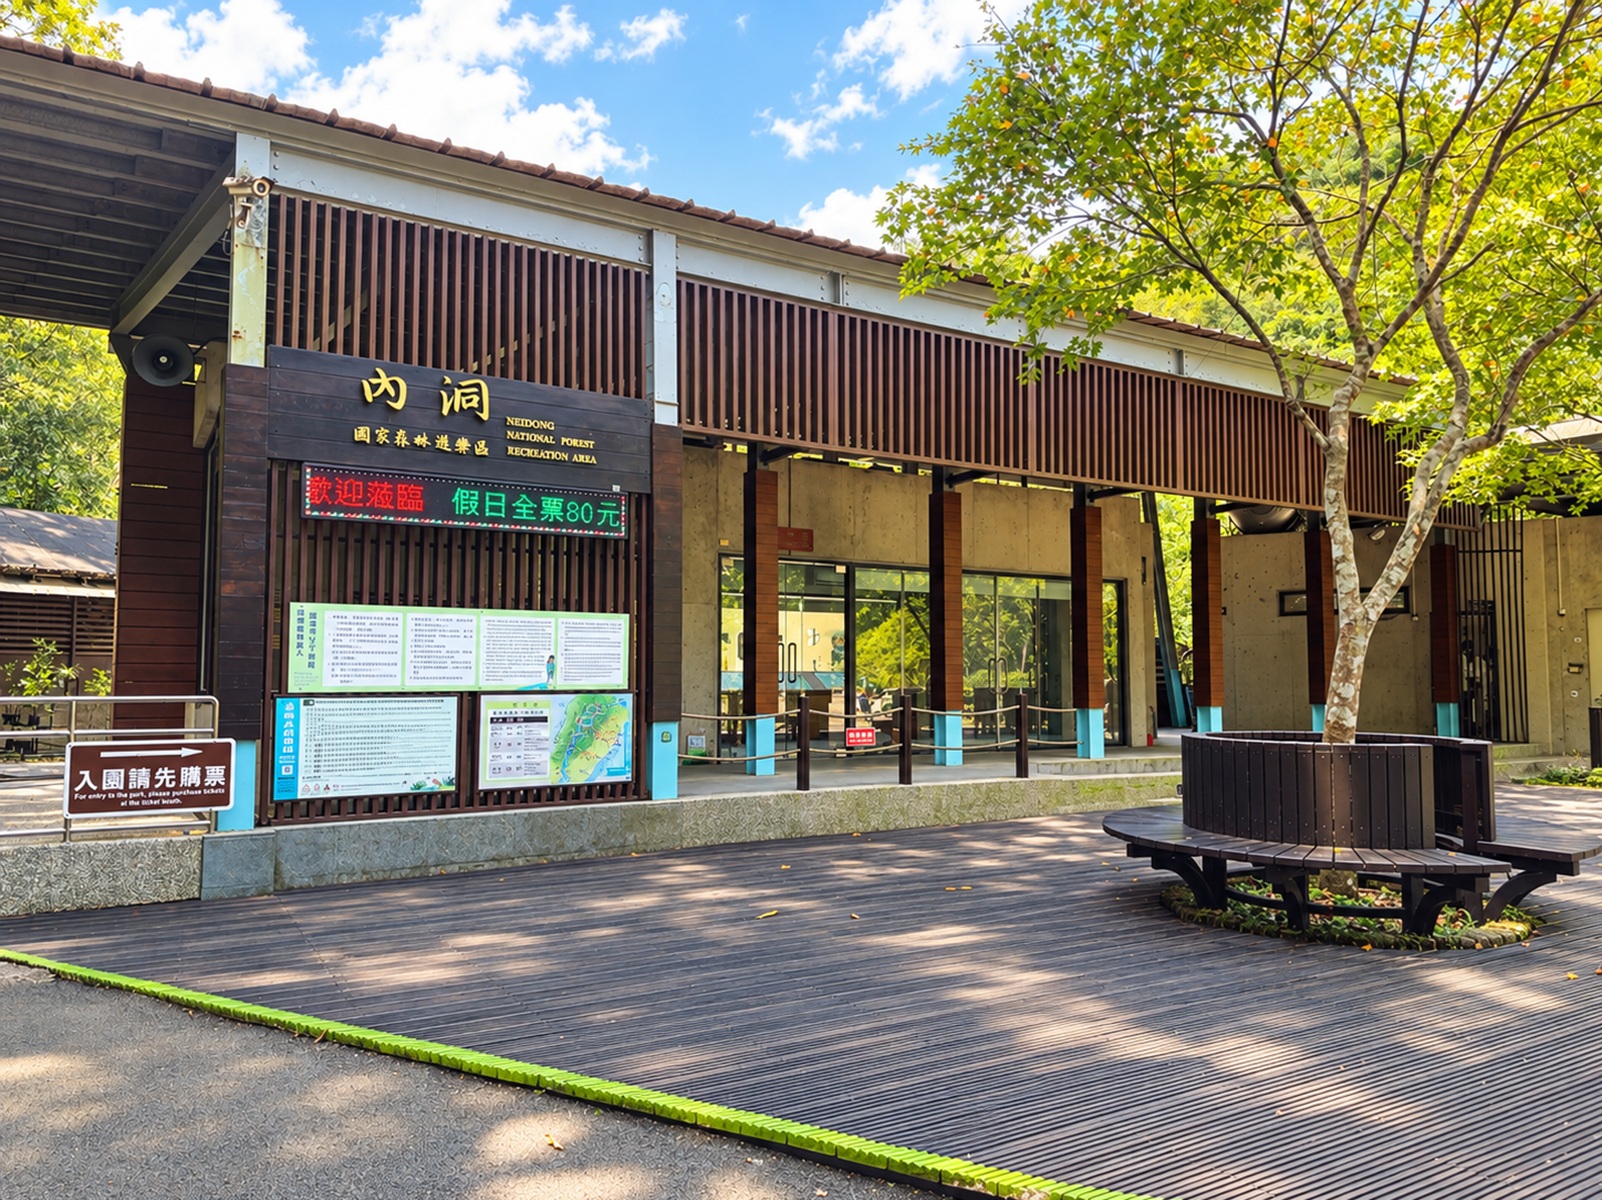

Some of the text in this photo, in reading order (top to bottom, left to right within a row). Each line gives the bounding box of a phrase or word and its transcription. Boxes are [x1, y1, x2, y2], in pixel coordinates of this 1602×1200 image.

[361, 367, 490, 421] 內洞
[505, 416, 555, 431] NEIDONG
[353, 425, 490, 457] 國家森林遊樂區
[506, 430, 596, 450] NATIONAL FOREST
[507, 446, 598, 465] RECREATION AREA
[309, 476, 620, 528] 歡迎蒞臨 假日全票80元
[73, 765, 227, 792] 入園請先購票
[74, 793, 87, 801] For
[88, 792, 107, 801] entry
